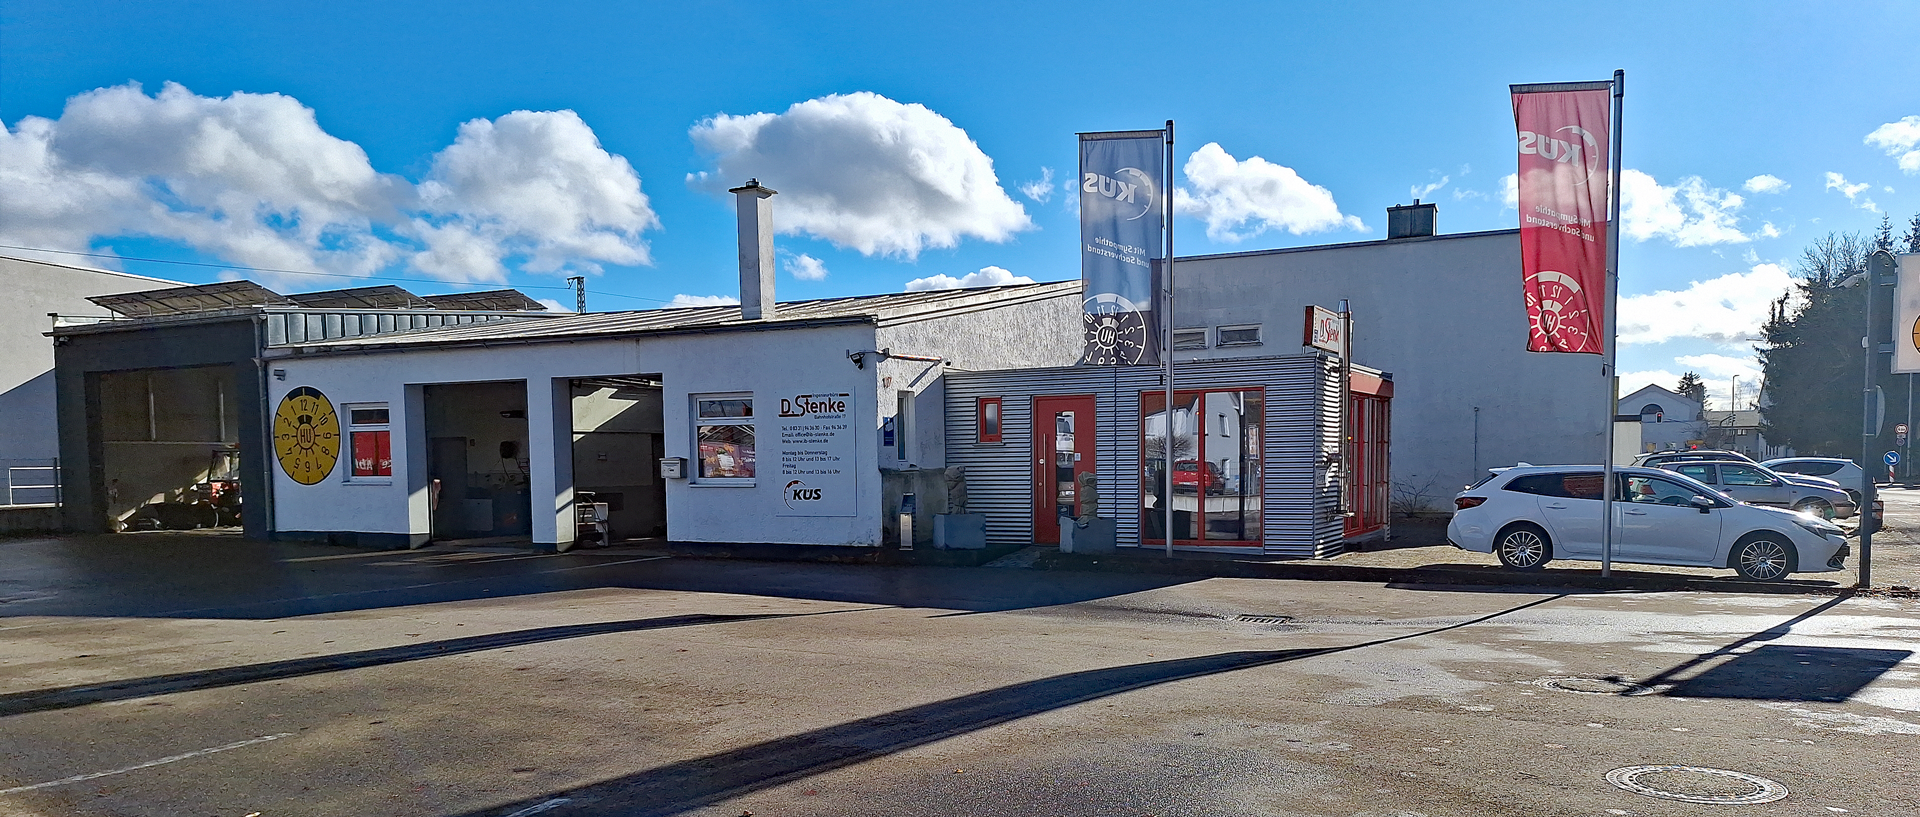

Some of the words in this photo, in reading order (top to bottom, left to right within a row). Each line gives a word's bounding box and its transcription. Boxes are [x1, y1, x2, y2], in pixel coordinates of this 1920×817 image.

[300, 399, 308, 411] 12
[311, 402, 319, 415] 11
[795, 394, 846, 417] Stenke
[284, 418, 292, 427] 2
[319, 413, 328, 426] 10
[300, 428, 312, 443] HU
[286, 447, 292, 456] 4
[322, 446, 330, 456] 8
[294, 458, 300, 470] 5
